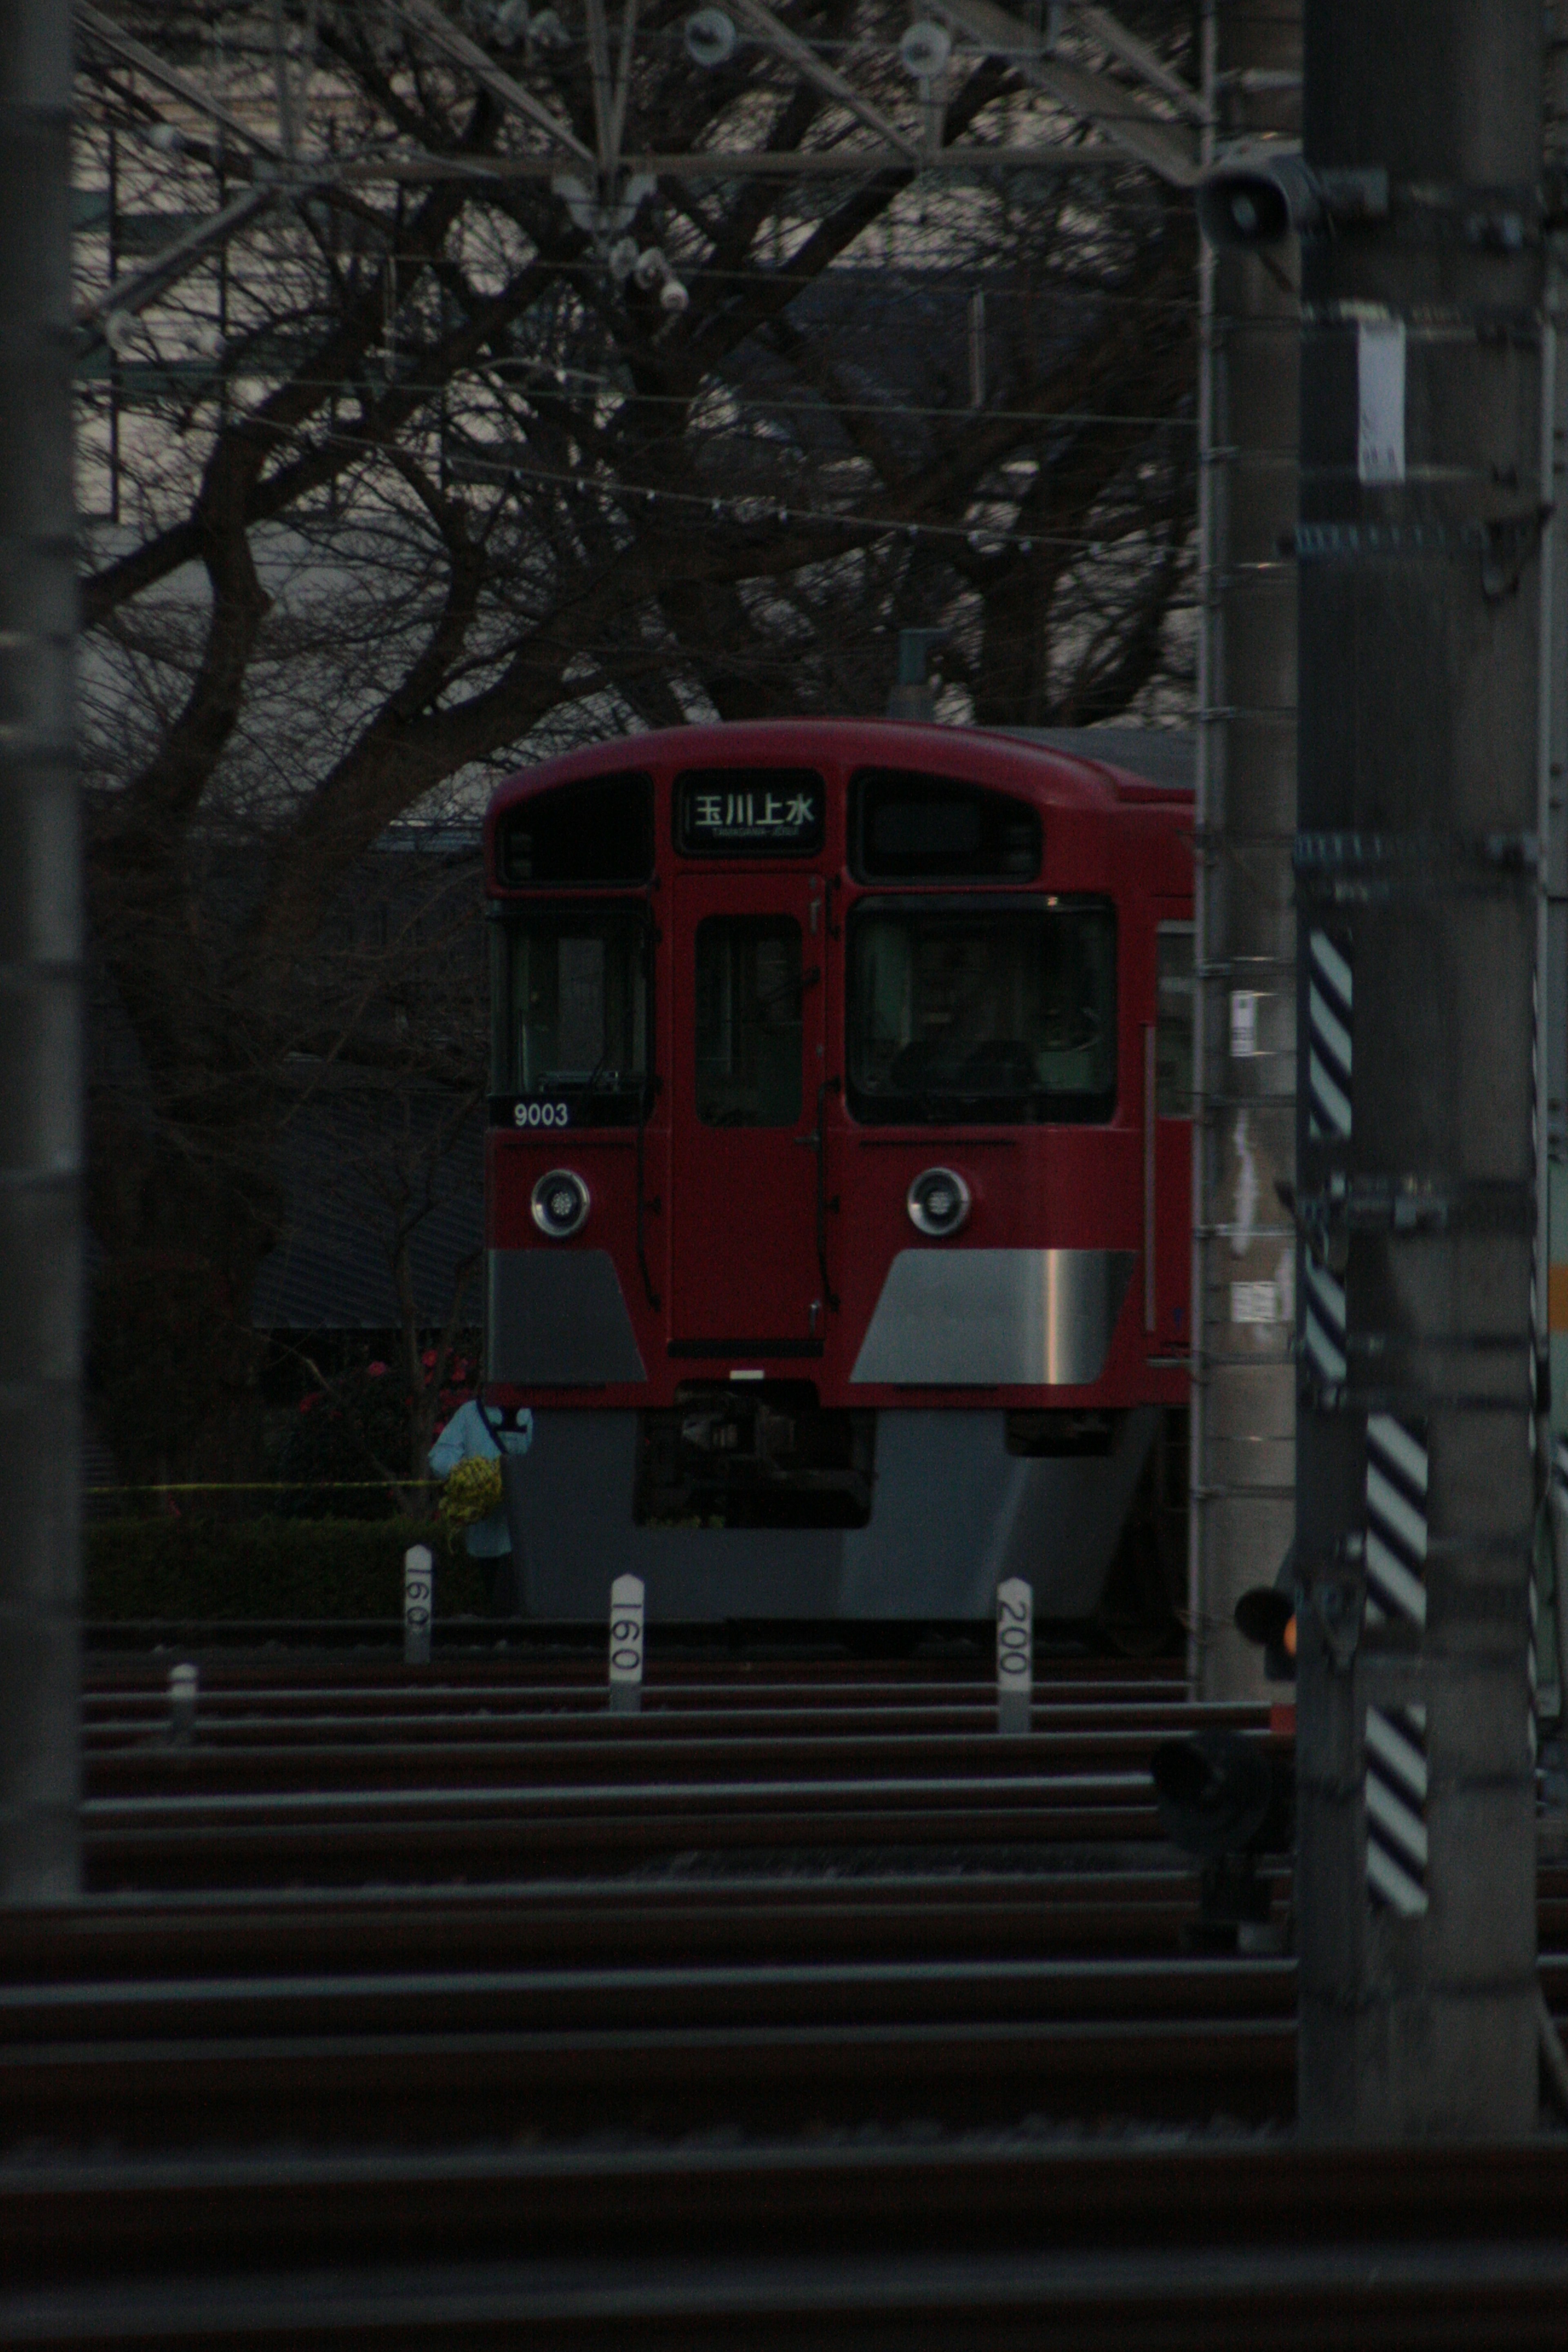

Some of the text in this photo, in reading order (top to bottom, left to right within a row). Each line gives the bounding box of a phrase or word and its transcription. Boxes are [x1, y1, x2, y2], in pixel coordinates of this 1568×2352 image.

[695, 792, 815, 826] 玉川上水
[514, 1103, 568, 1126] 9003
[408, 1568, 430, 1625] 160
[612, 1604, 641, 1670] 160
[999, 1600, 1027, 1674] 200
